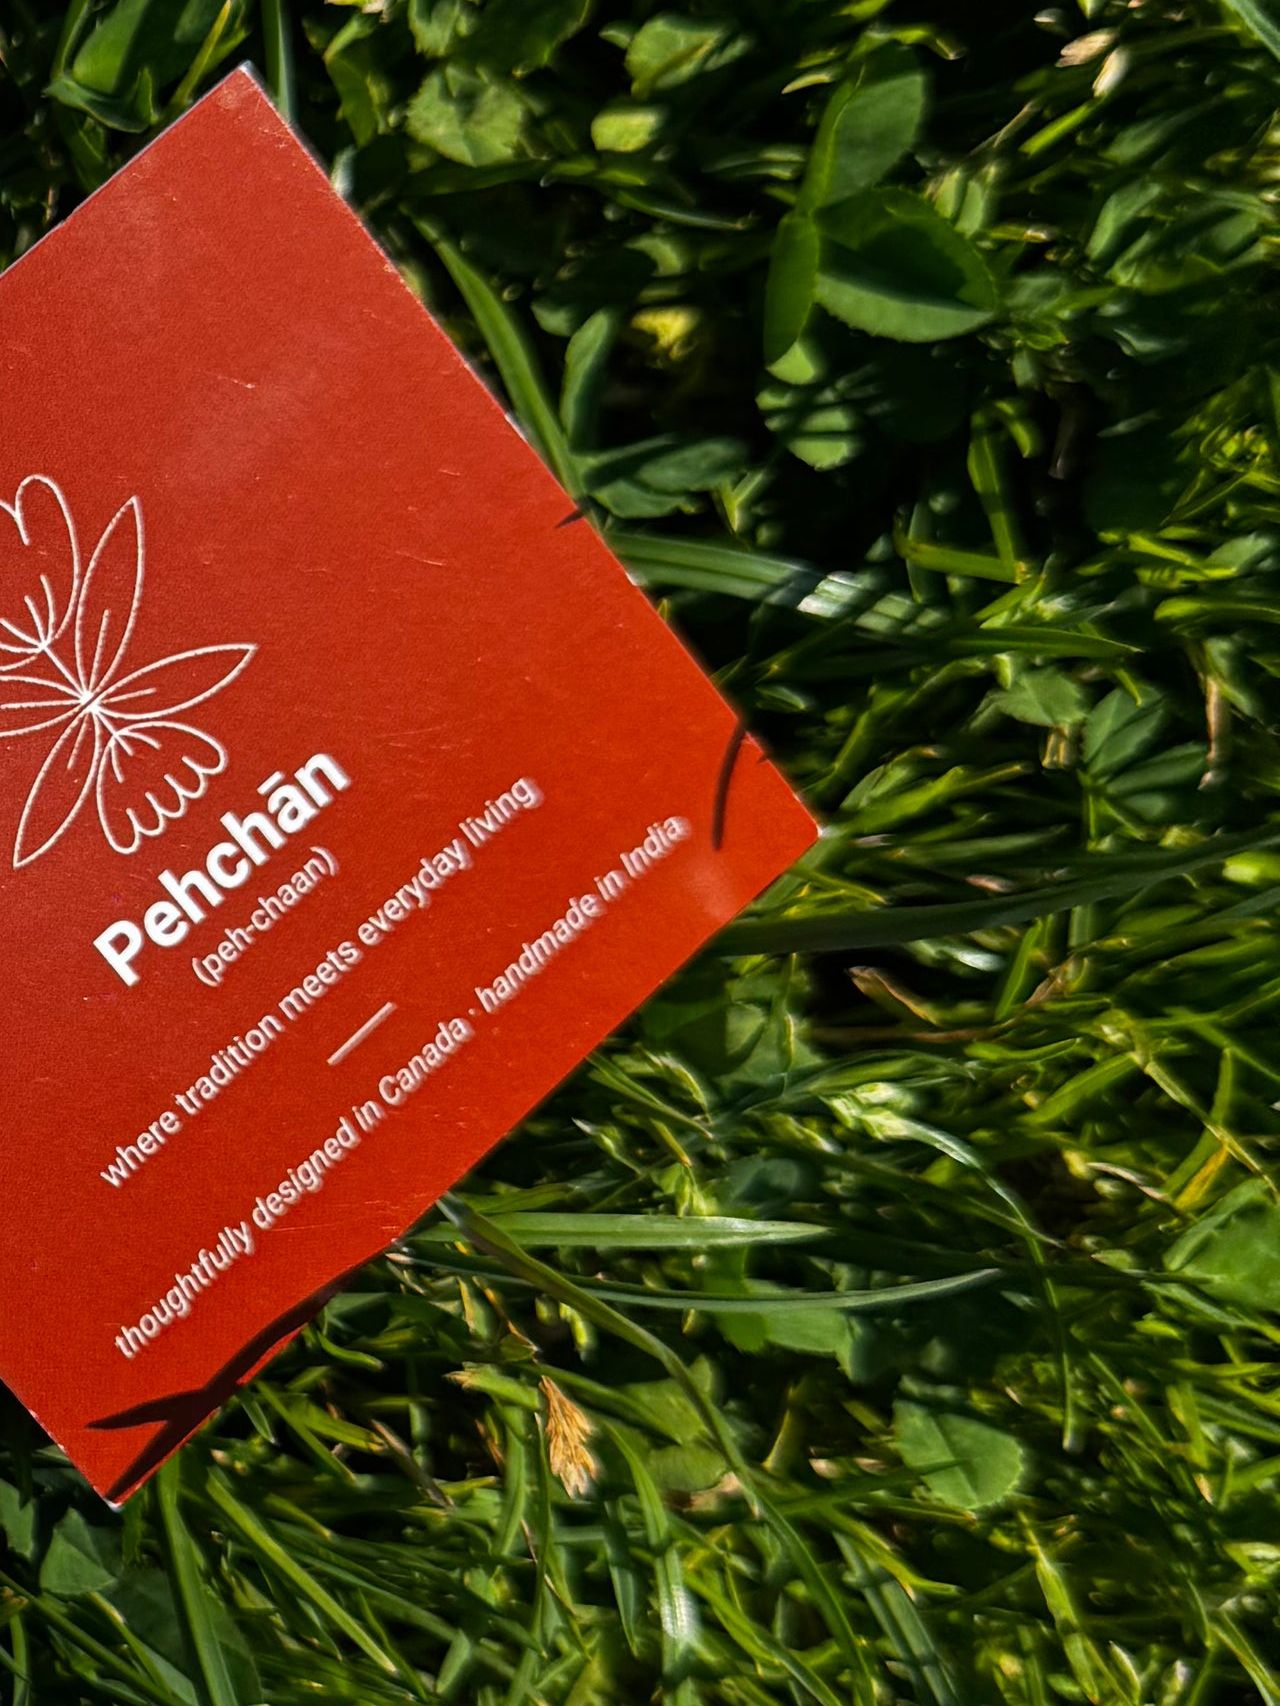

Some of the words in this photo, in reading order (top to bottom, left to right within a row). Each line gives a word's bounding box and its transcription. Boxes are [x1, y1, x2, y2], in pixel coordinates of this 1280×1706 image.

[93, 754, 351, 986] Pehchān
[100, 1112, 180, 1187] where
[175, 1015, 284, 1115] tradition
[279, 942, 361, 1019] meets
[358, 839, 469, 945] everyday
[459, 778, 540, 846] living
[192, 848, 337, 986] (peh-chaan)
[115, 1222, 253, 1358] thoughtfully
[253, 1118, 359, 1229] designed
[352, 1101, 384, 1131] in
[379, 1018, 471, 1105] Canada
[475, 895, 600, 1012] handmade
[594, 871, 624, 900] in
[620, 817, 687, 877] India
